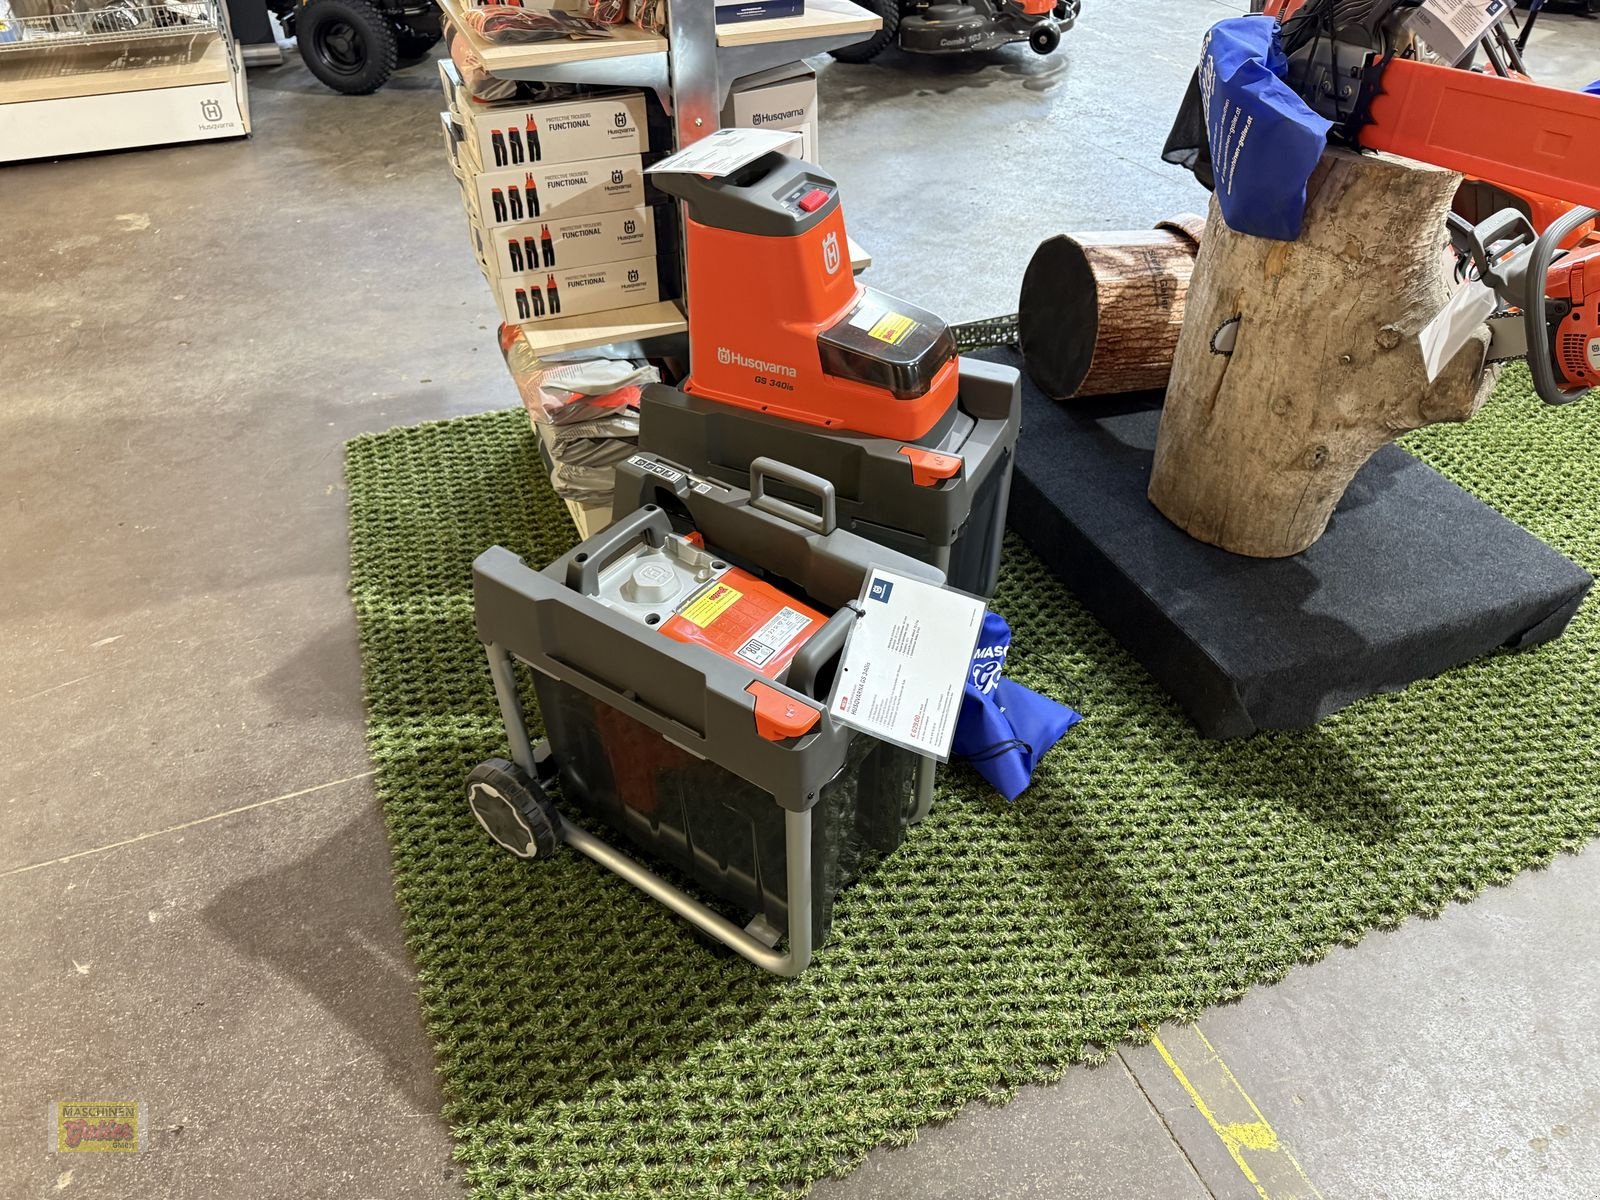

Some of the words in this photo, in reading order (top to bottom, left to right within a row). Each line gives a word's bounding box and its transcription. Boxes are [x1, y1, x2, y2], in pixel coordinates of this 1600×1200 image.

[546, 114, 569, 122] PROTECTIVE
[762, 107, 804, 124] Husqvarna
[198, 122, 234, 131] Husqvarna
[548, 119, 590, 131] FUNCTIONAL
[607, 127, 636, 135] Husqvarna
[547, 177, 588, 189] FUNCTIONAL
[604, 183, 632, 191] Husqvarna
[562, 228, 602, 239] FUNCTIONAL
[617, 233, 644, 241] Husqvarna
[567, 277, 606, 288] FUNCTIONAL
[621, 281, 647, 289] Husqvarna
[731, 351, 797, 377] Husqvarna
[754, 375, 767, 385] GS
[769, 379, 794, 391] 340is
